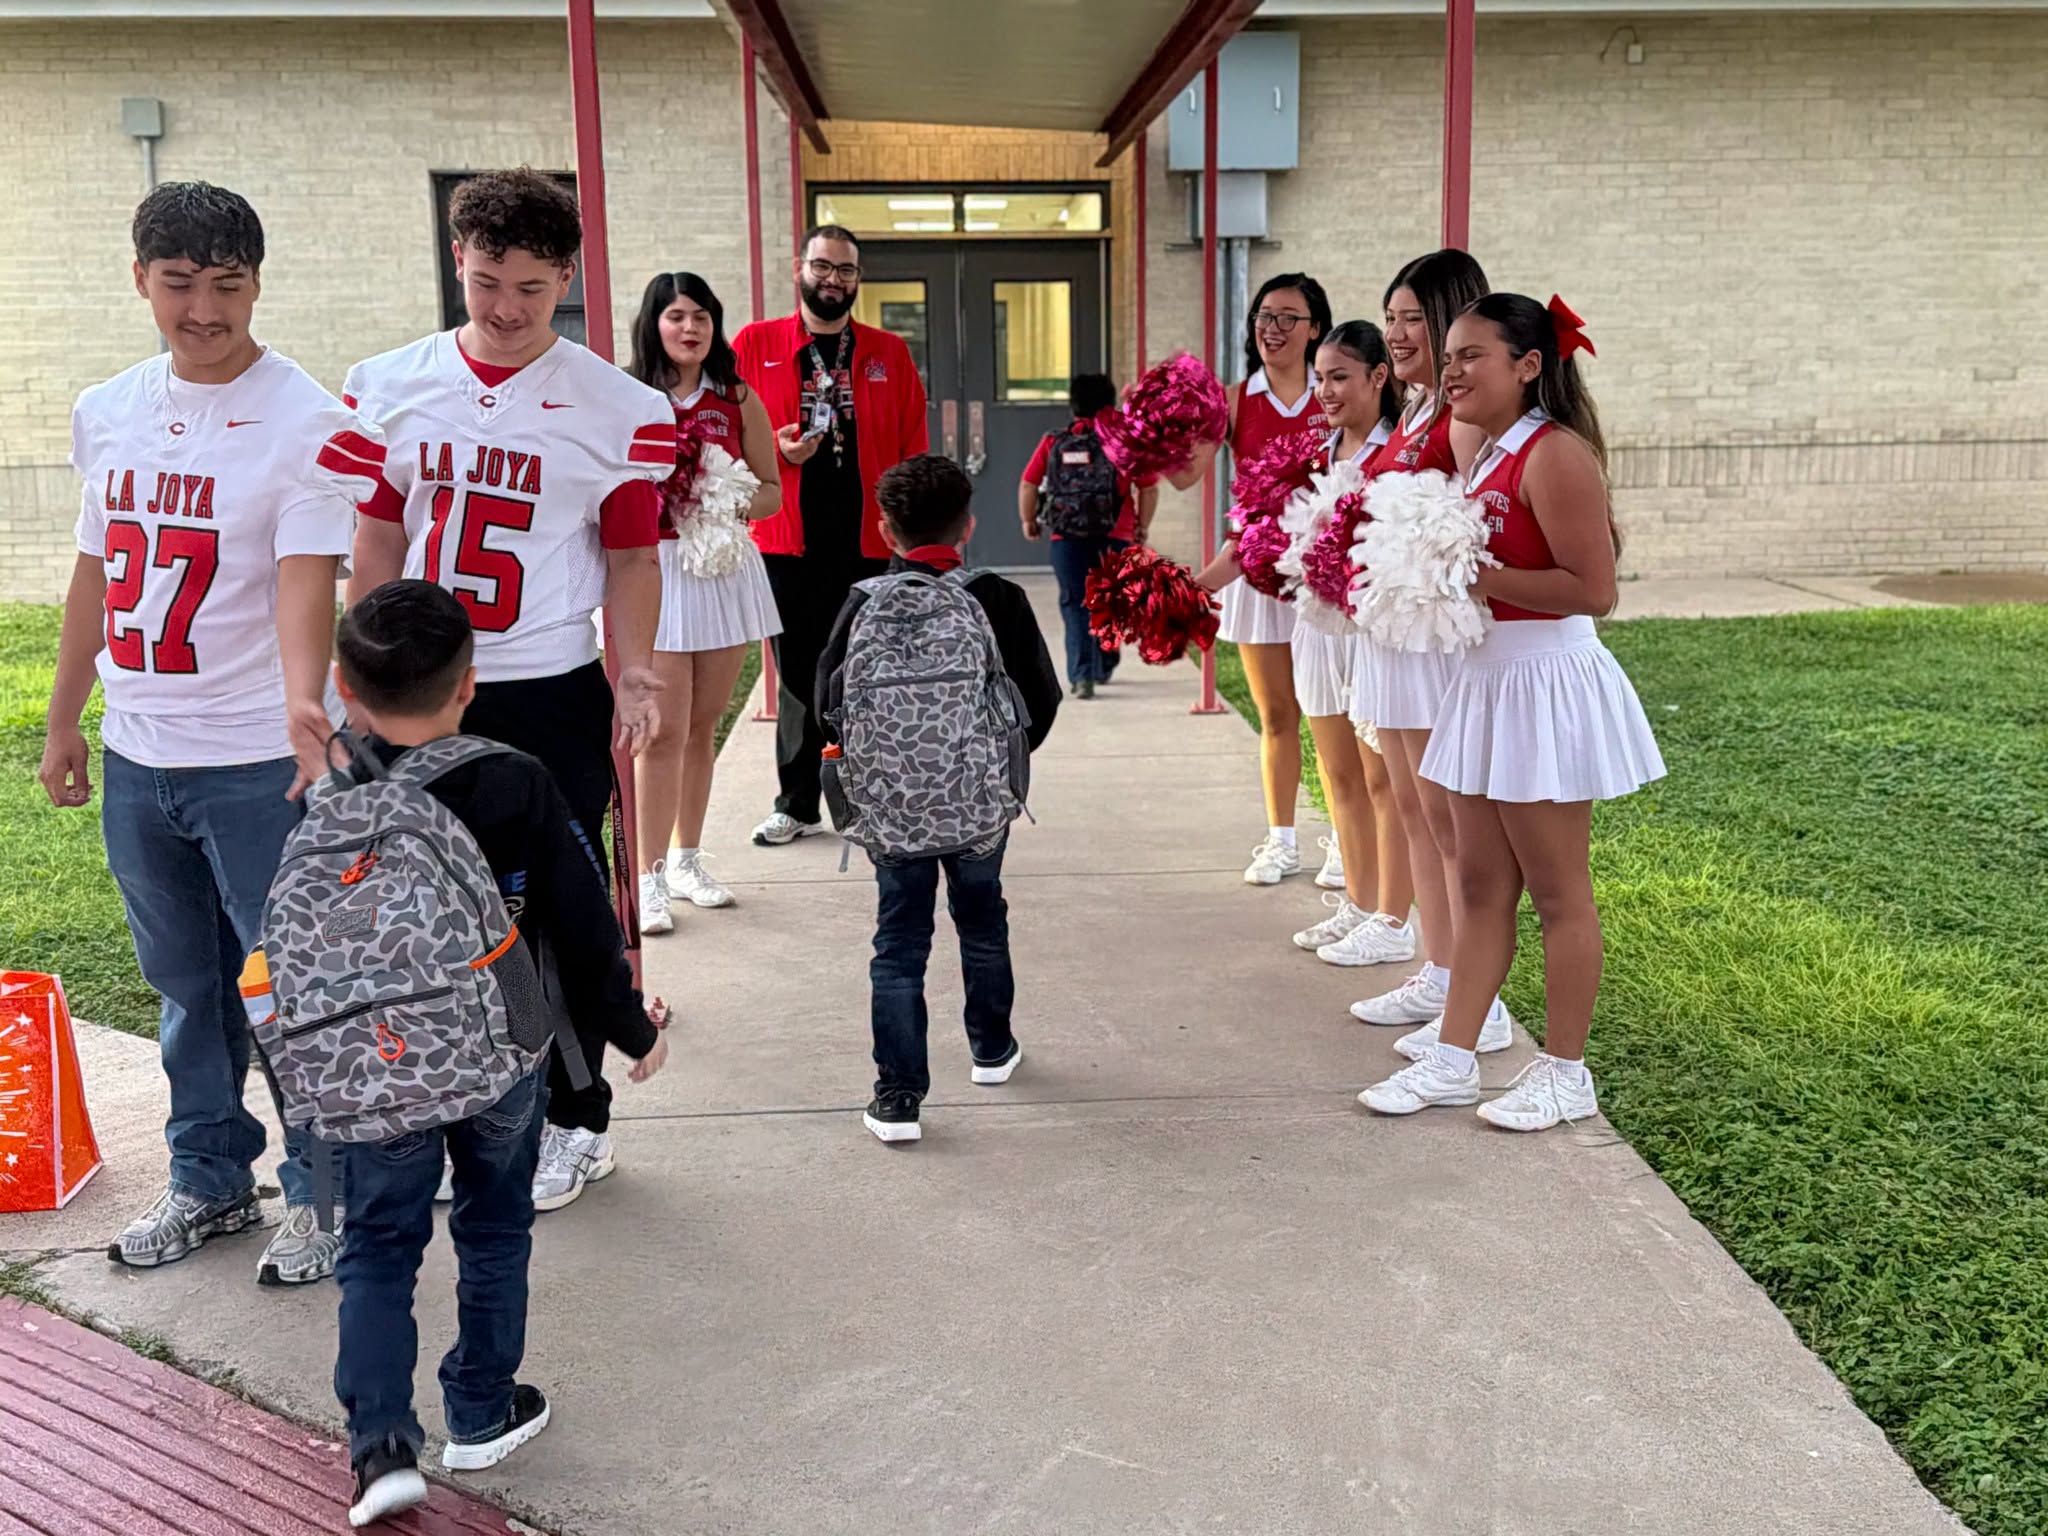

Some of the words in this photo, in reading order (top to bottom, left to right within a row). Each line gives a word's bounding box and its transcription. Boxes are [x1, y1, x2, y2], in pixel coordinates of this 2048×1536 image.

[105, 469, 135, 511] LA
[147, 472, 215, 519] JOYA
[419, 442, 453, 481] LA
[467, 446, 542, 495] JOYA
[423, 485, 535, 634] 15
[104, 519, 220, 674] 27
[614, 807, 625, 839] STATION
